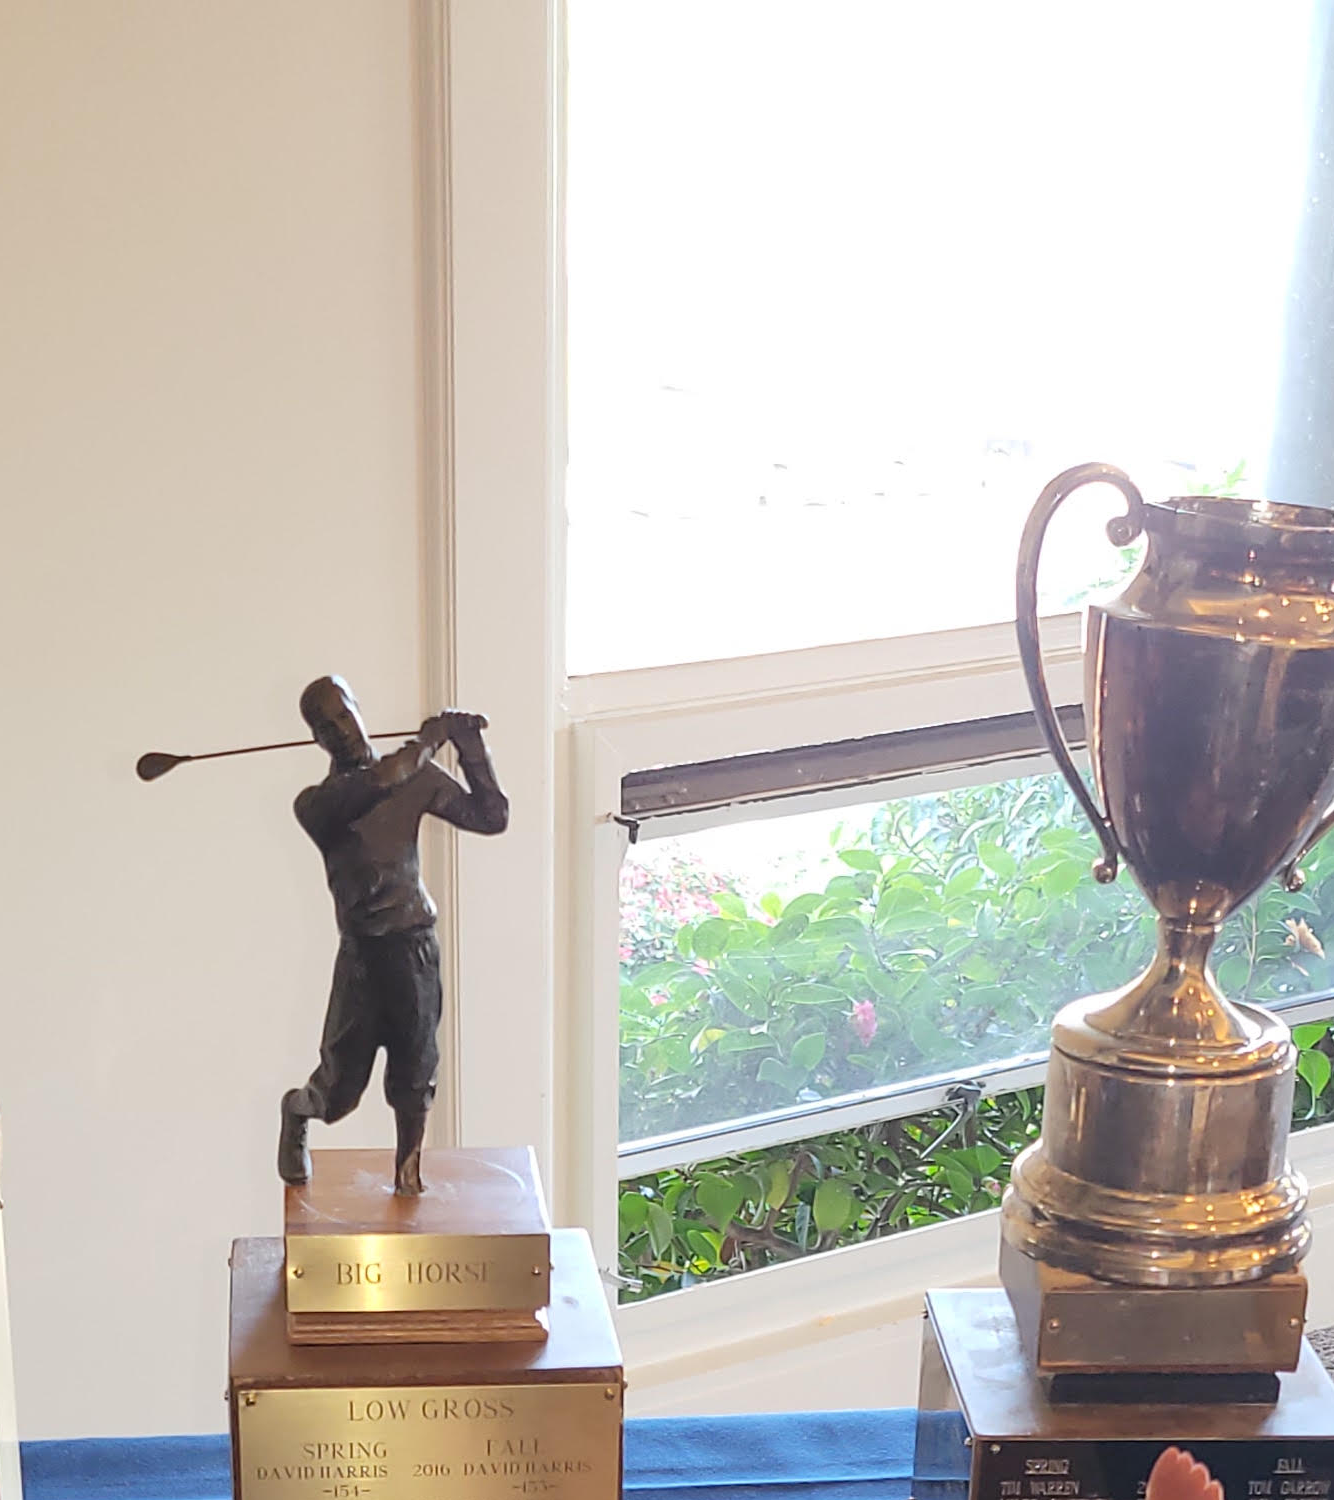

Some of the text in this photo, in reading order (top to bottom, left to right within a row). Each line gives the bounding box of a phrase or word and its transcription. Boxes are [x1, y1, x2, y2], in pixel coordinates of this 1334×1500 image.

[336, 1260, 495, 1285] BIG HORSE
[348, 1397, 515, 1422] LOW GROSS
[301, 1441, 388, 1460] SPRING
[486, 1438, 540, 1457] FALL
[257, 1460, 594, 1480] DAVID HARRIS 2016 DAVID HARRIS
[1024, 1459, 1070, 1473] SPRING
[1030, 1480, 1080, 1496] WARREN
[1248, 1480, 1272, 1495] TOM
